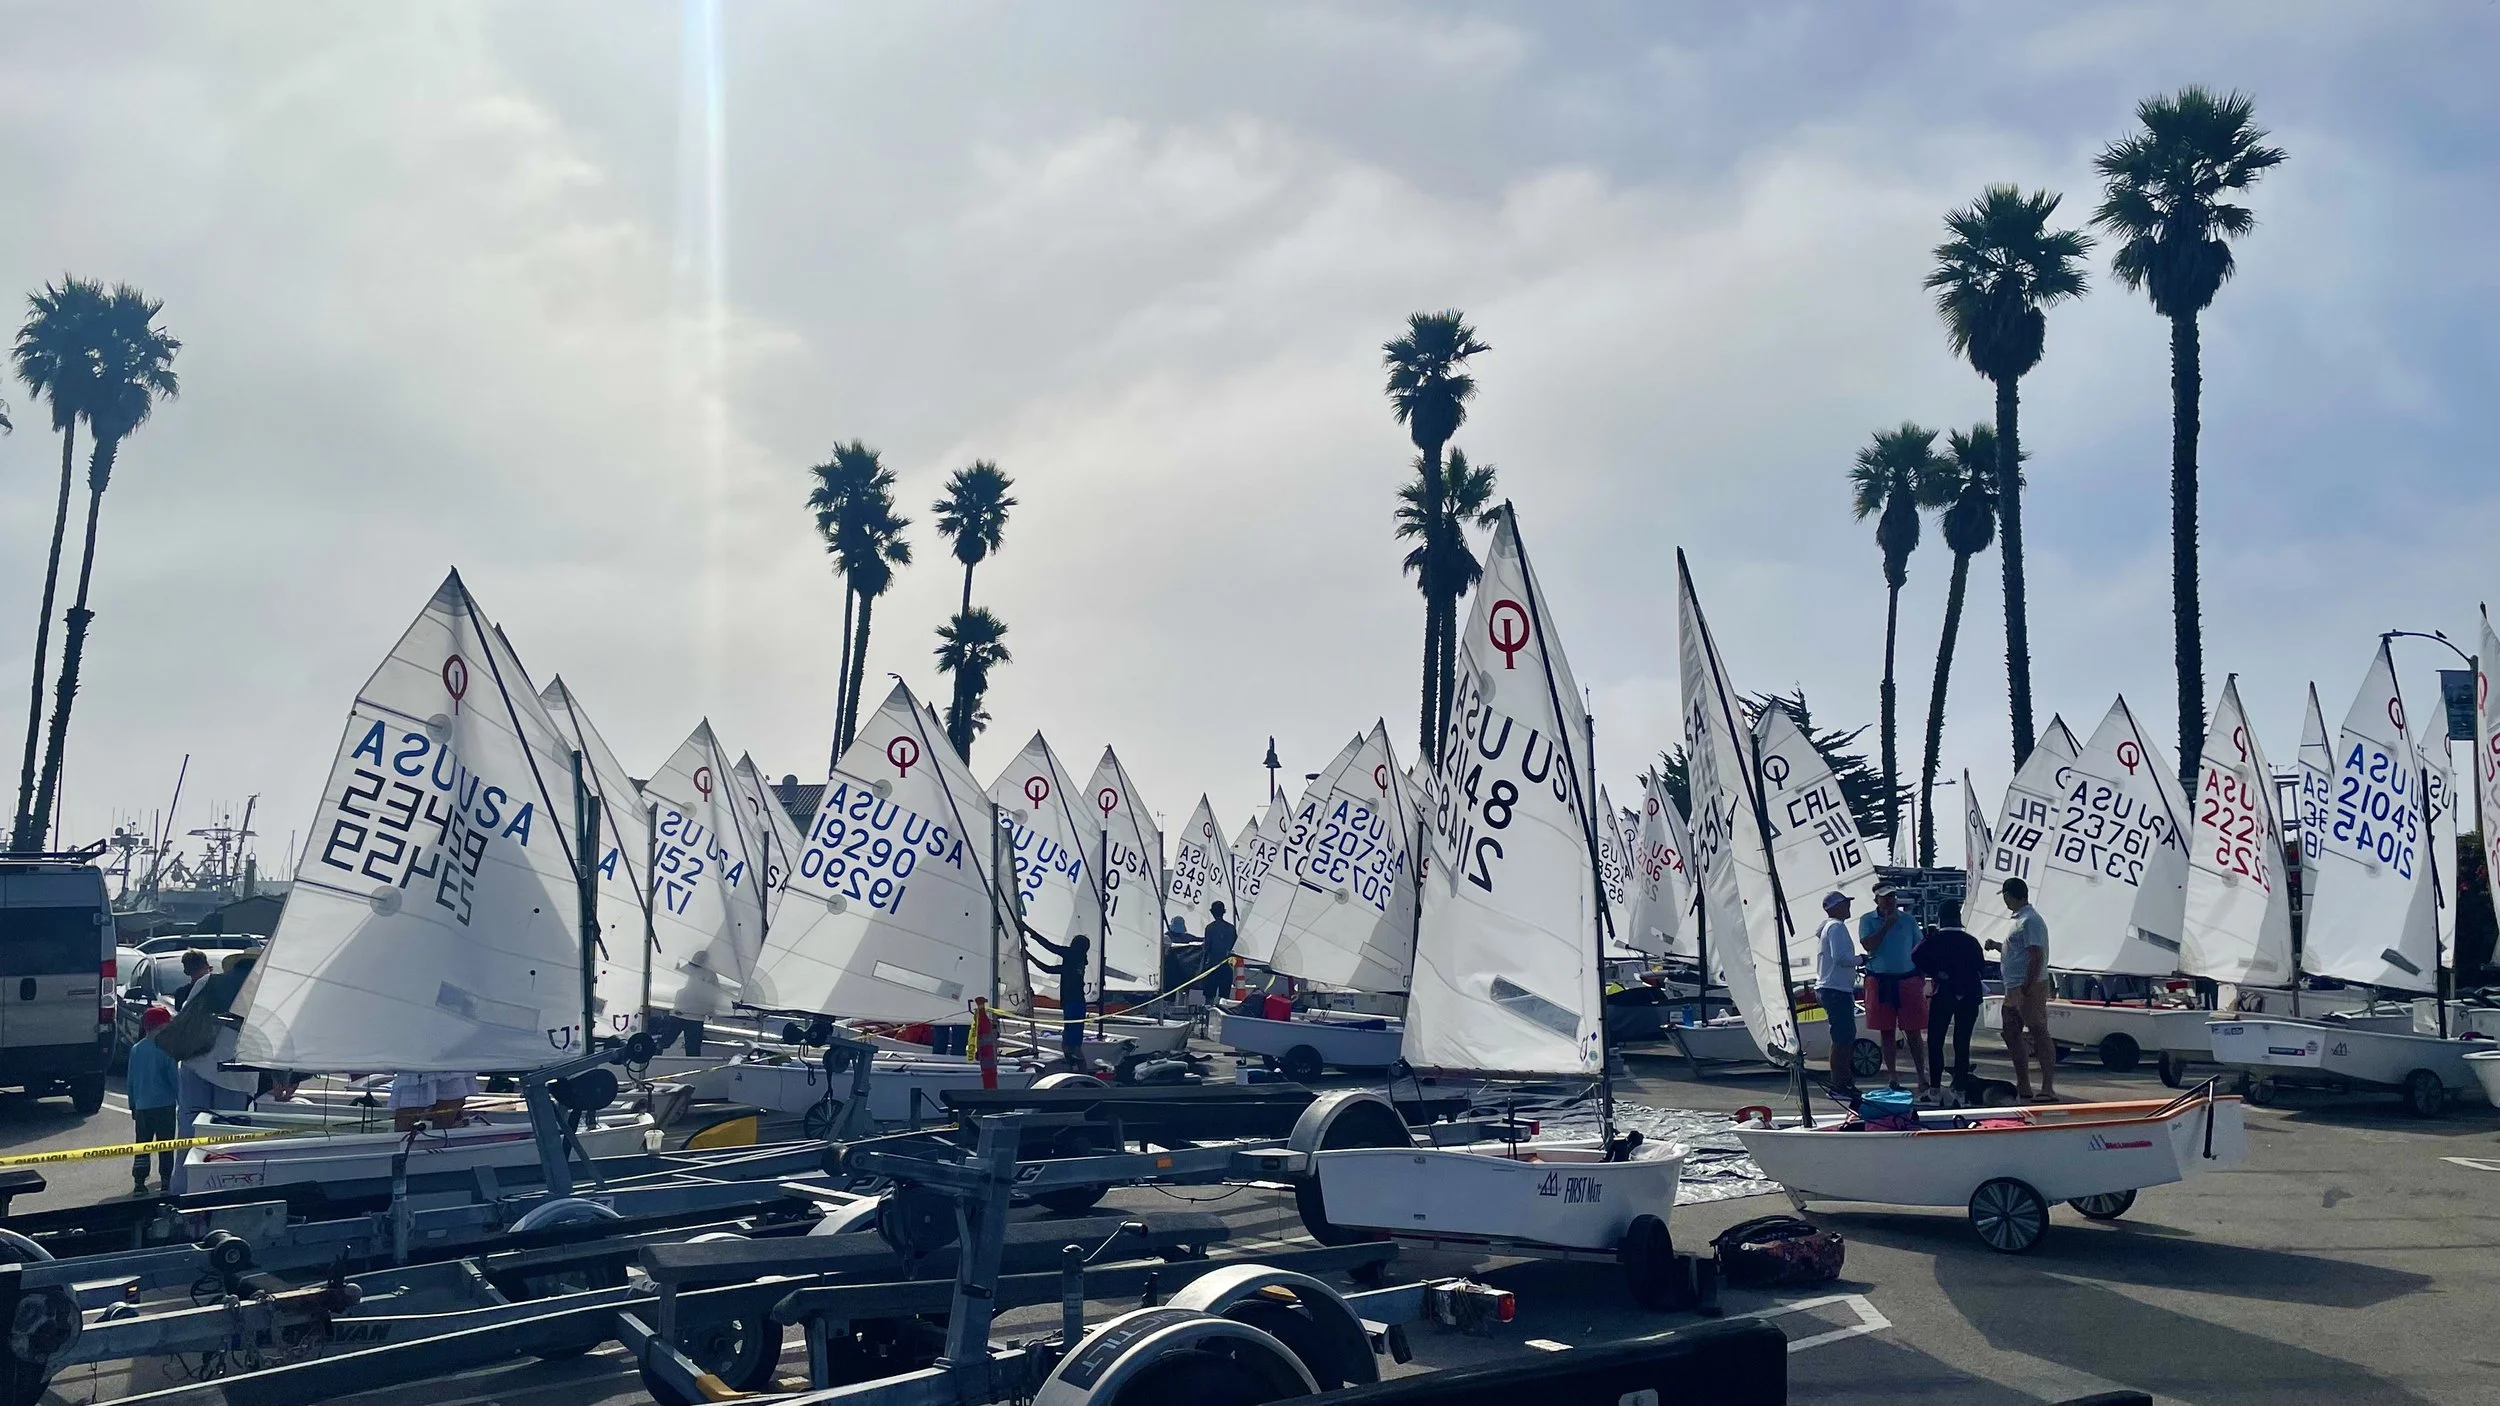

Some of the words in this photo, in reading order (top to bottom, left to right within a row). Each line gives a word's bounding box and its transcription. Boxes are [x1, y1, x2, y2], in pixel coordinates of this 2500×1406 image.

[1685, 698, 1705, 761] SA
[1445, 727, 1518, 829] 21148
[338, 768, 488, 877] 23459
[459, 767, 533, 846] USA
[1787, 786, 1840, 828] CAL
[2139, 803, 2175, 850] USA
[2338, 777, 2417, 843] 21045
[812, 813, 916, 878] 19290
[903, 813, 963, 869] USA
[2001, 823, 2043, 851] 118
[2062, 807, 2149, 859] 23761
[654, 842, 703, 886] 152
[767, 865, 789, 893] SA
[1037, 838, 1082, 884] USA
[1111, 842, 1146, 881] USA
[1176, 862, 1204, 886] 349
[1652, 841, 1684, 873] USA
[1830, 839, 1861, 876] 116
[1564, 1177, 1587, 1203] FIRST
